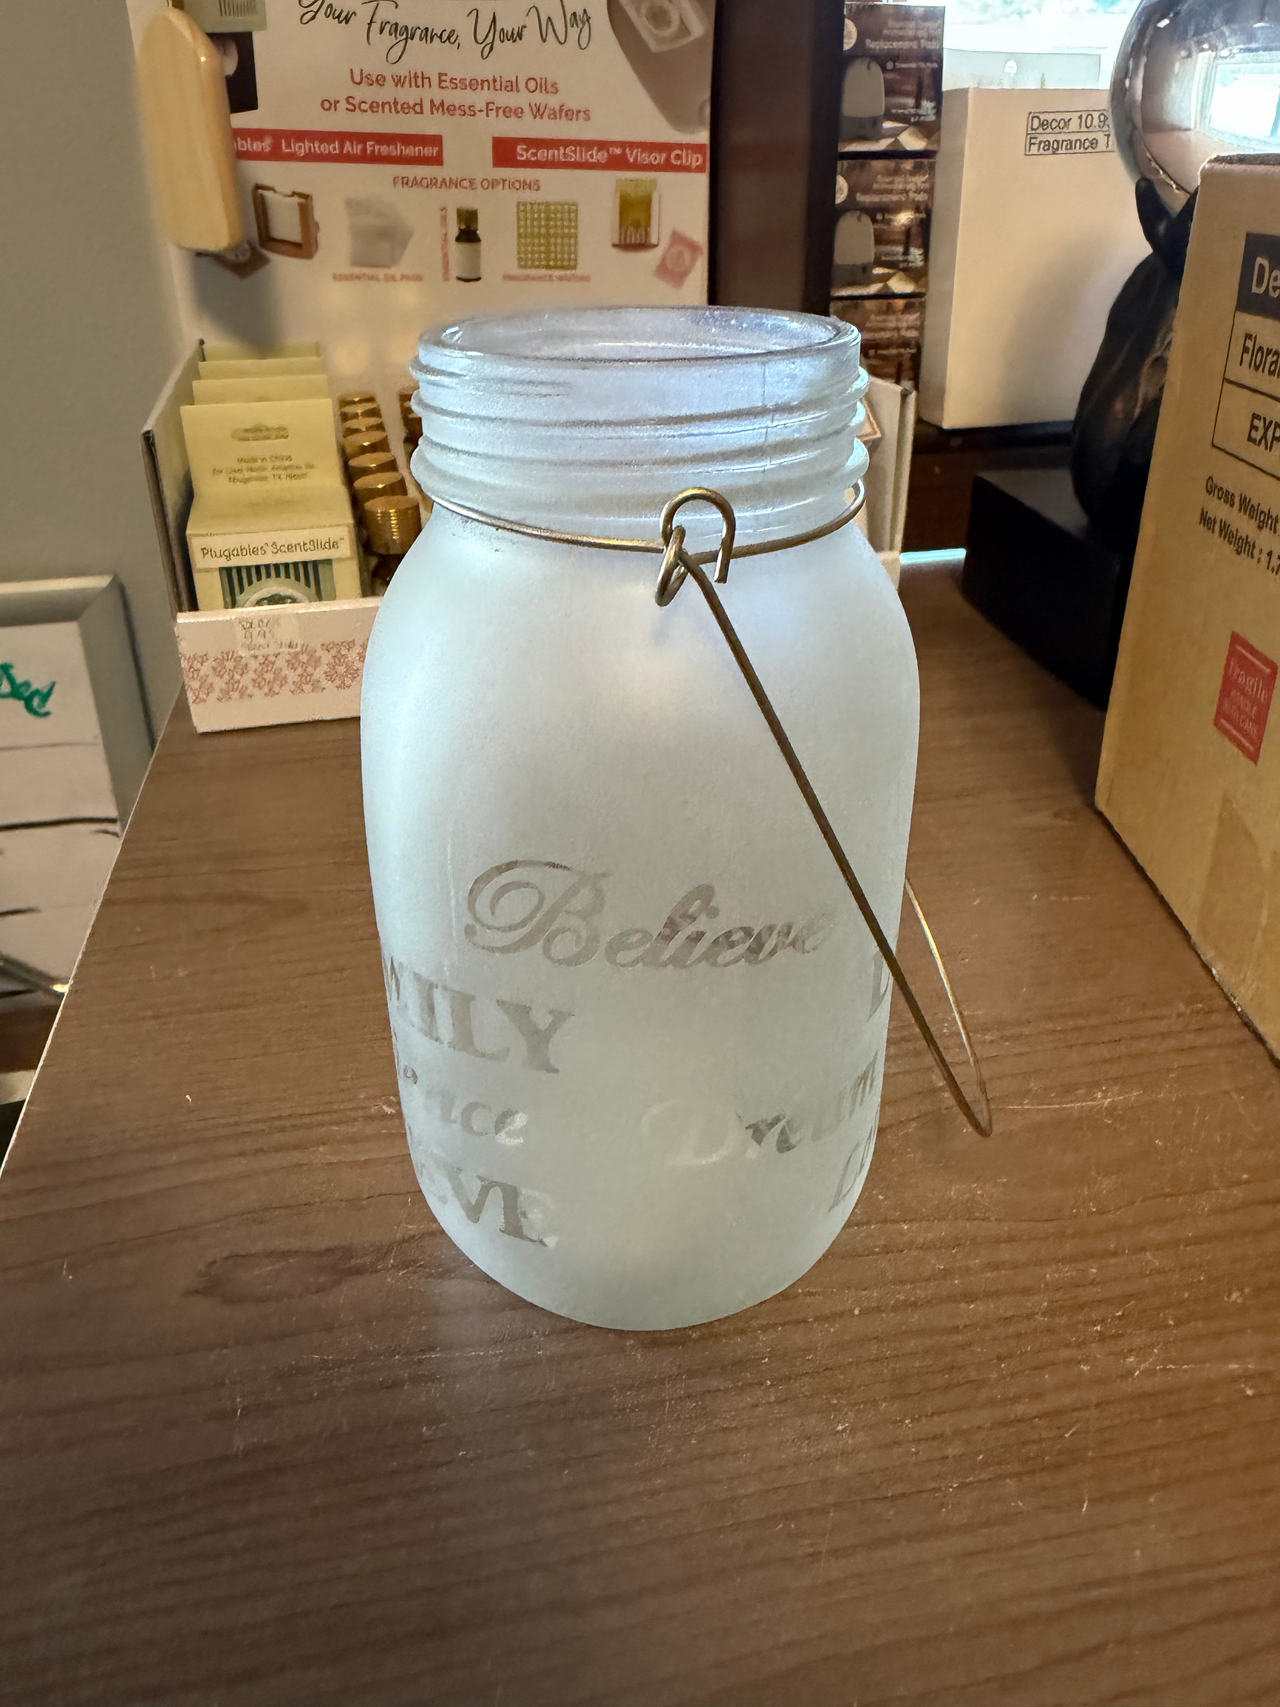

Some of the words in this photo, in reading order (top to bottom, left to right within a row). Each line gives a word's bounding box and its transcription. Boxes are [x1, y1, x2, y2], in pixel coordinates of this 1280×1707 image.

[361, 0, 461, 64] Fragrance,
[467, 8, 527, 60] Your
[526, 0, 593, 50] Way
[350, 68, 386, 88] Use
[392, 70, 432, 89] with
[437, 72, 520, 93] Essential
[525, 77, 560, 95] Oils
[320, 98, 340, 112] or
[345, 96, 424, 115] Scented
[429, 98, 525, 119] Mess-Free
[529, 102, 592, 122] Wafers
[1030, 115, 1072, 131] Decor
[1078, 113, 1110, 130] 10.9
[281, 138, 339, 156] Lighted
[343, 141, 362, 155] Air
[366, 141, 439, 157] Freshener
[625, 147, 667, 165] Visor
[670, 149, 703, 168] Clip
[1028, 135, 1099, 154] Fragrance
[392, 176, 478, 190] FRAGRANCE
[480, 178, 541, 192] OPTIONS
[1205, 475, 1236, 508] Gross
[1238, 492, 1279, 534] Weight
[1199, 507, 1217, 534] Net
[1219, 518, 1256, 560] Weight
[464, 858, 834, 969] Believe
